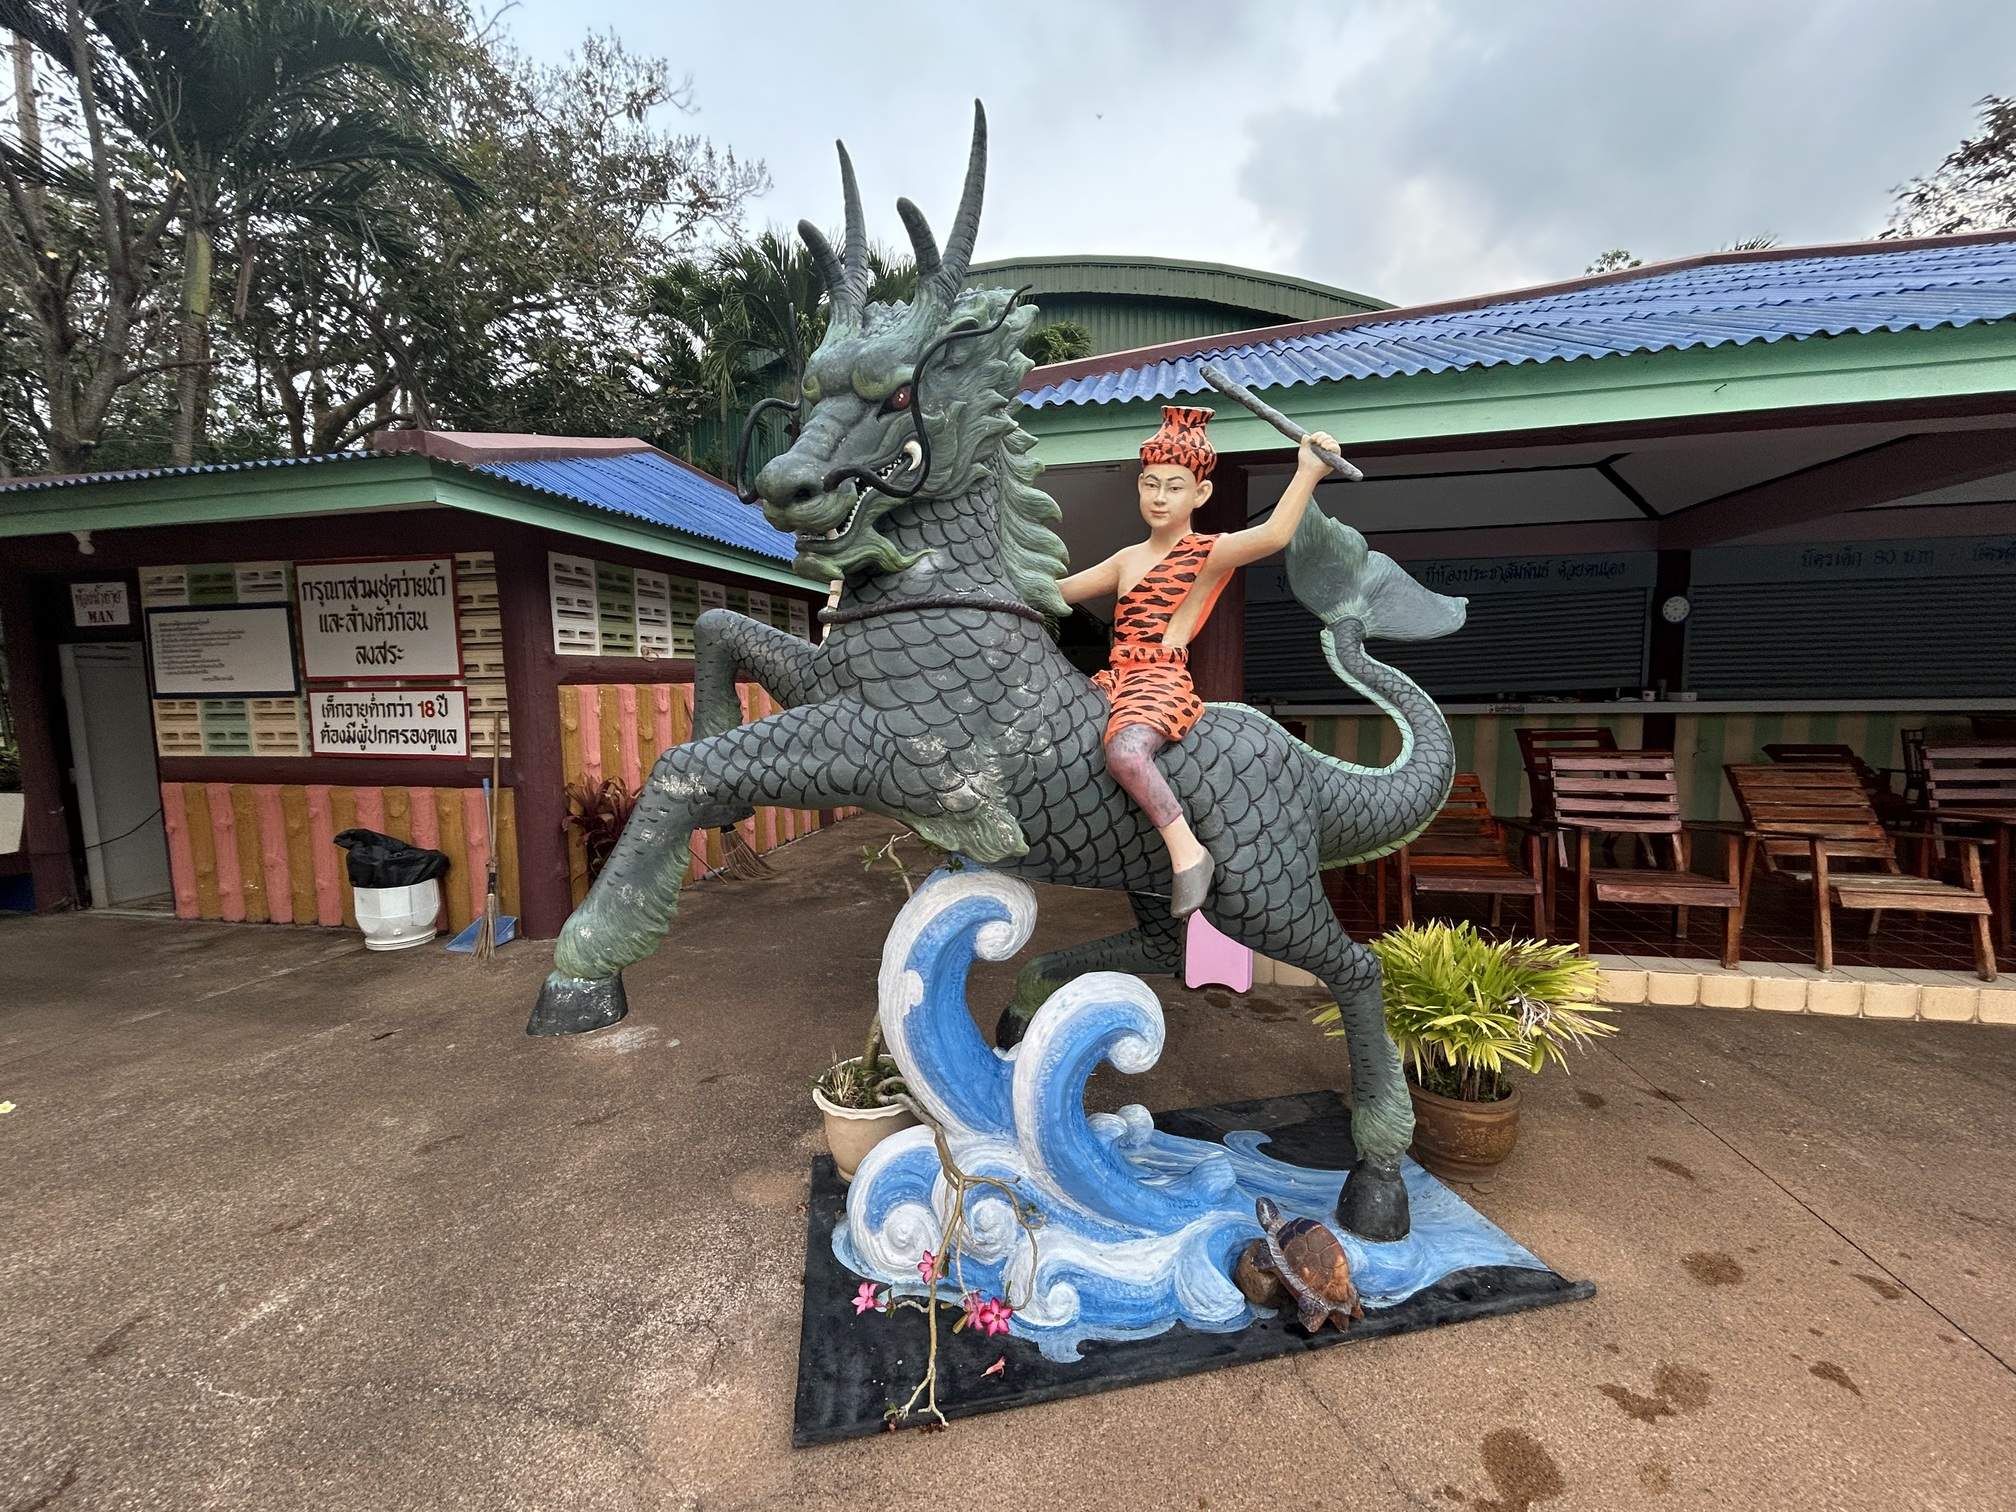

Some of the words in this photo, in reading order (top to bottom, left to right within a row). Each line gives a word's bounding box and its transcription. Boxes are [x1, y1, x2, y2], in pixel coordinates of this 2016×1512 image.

[319, 603, 428, 633] และล้างตัวก่อน
[355, 641, 404, 665] ลงสระ
[321, 693, 413, 724] เด็กอายุต่ำกว่า
[417, 700, 436, 719] 18
[436, 693, 449, 718] ปี
[320, 721, 458, 751] ต้องมีผู้ปกครองดูแล
